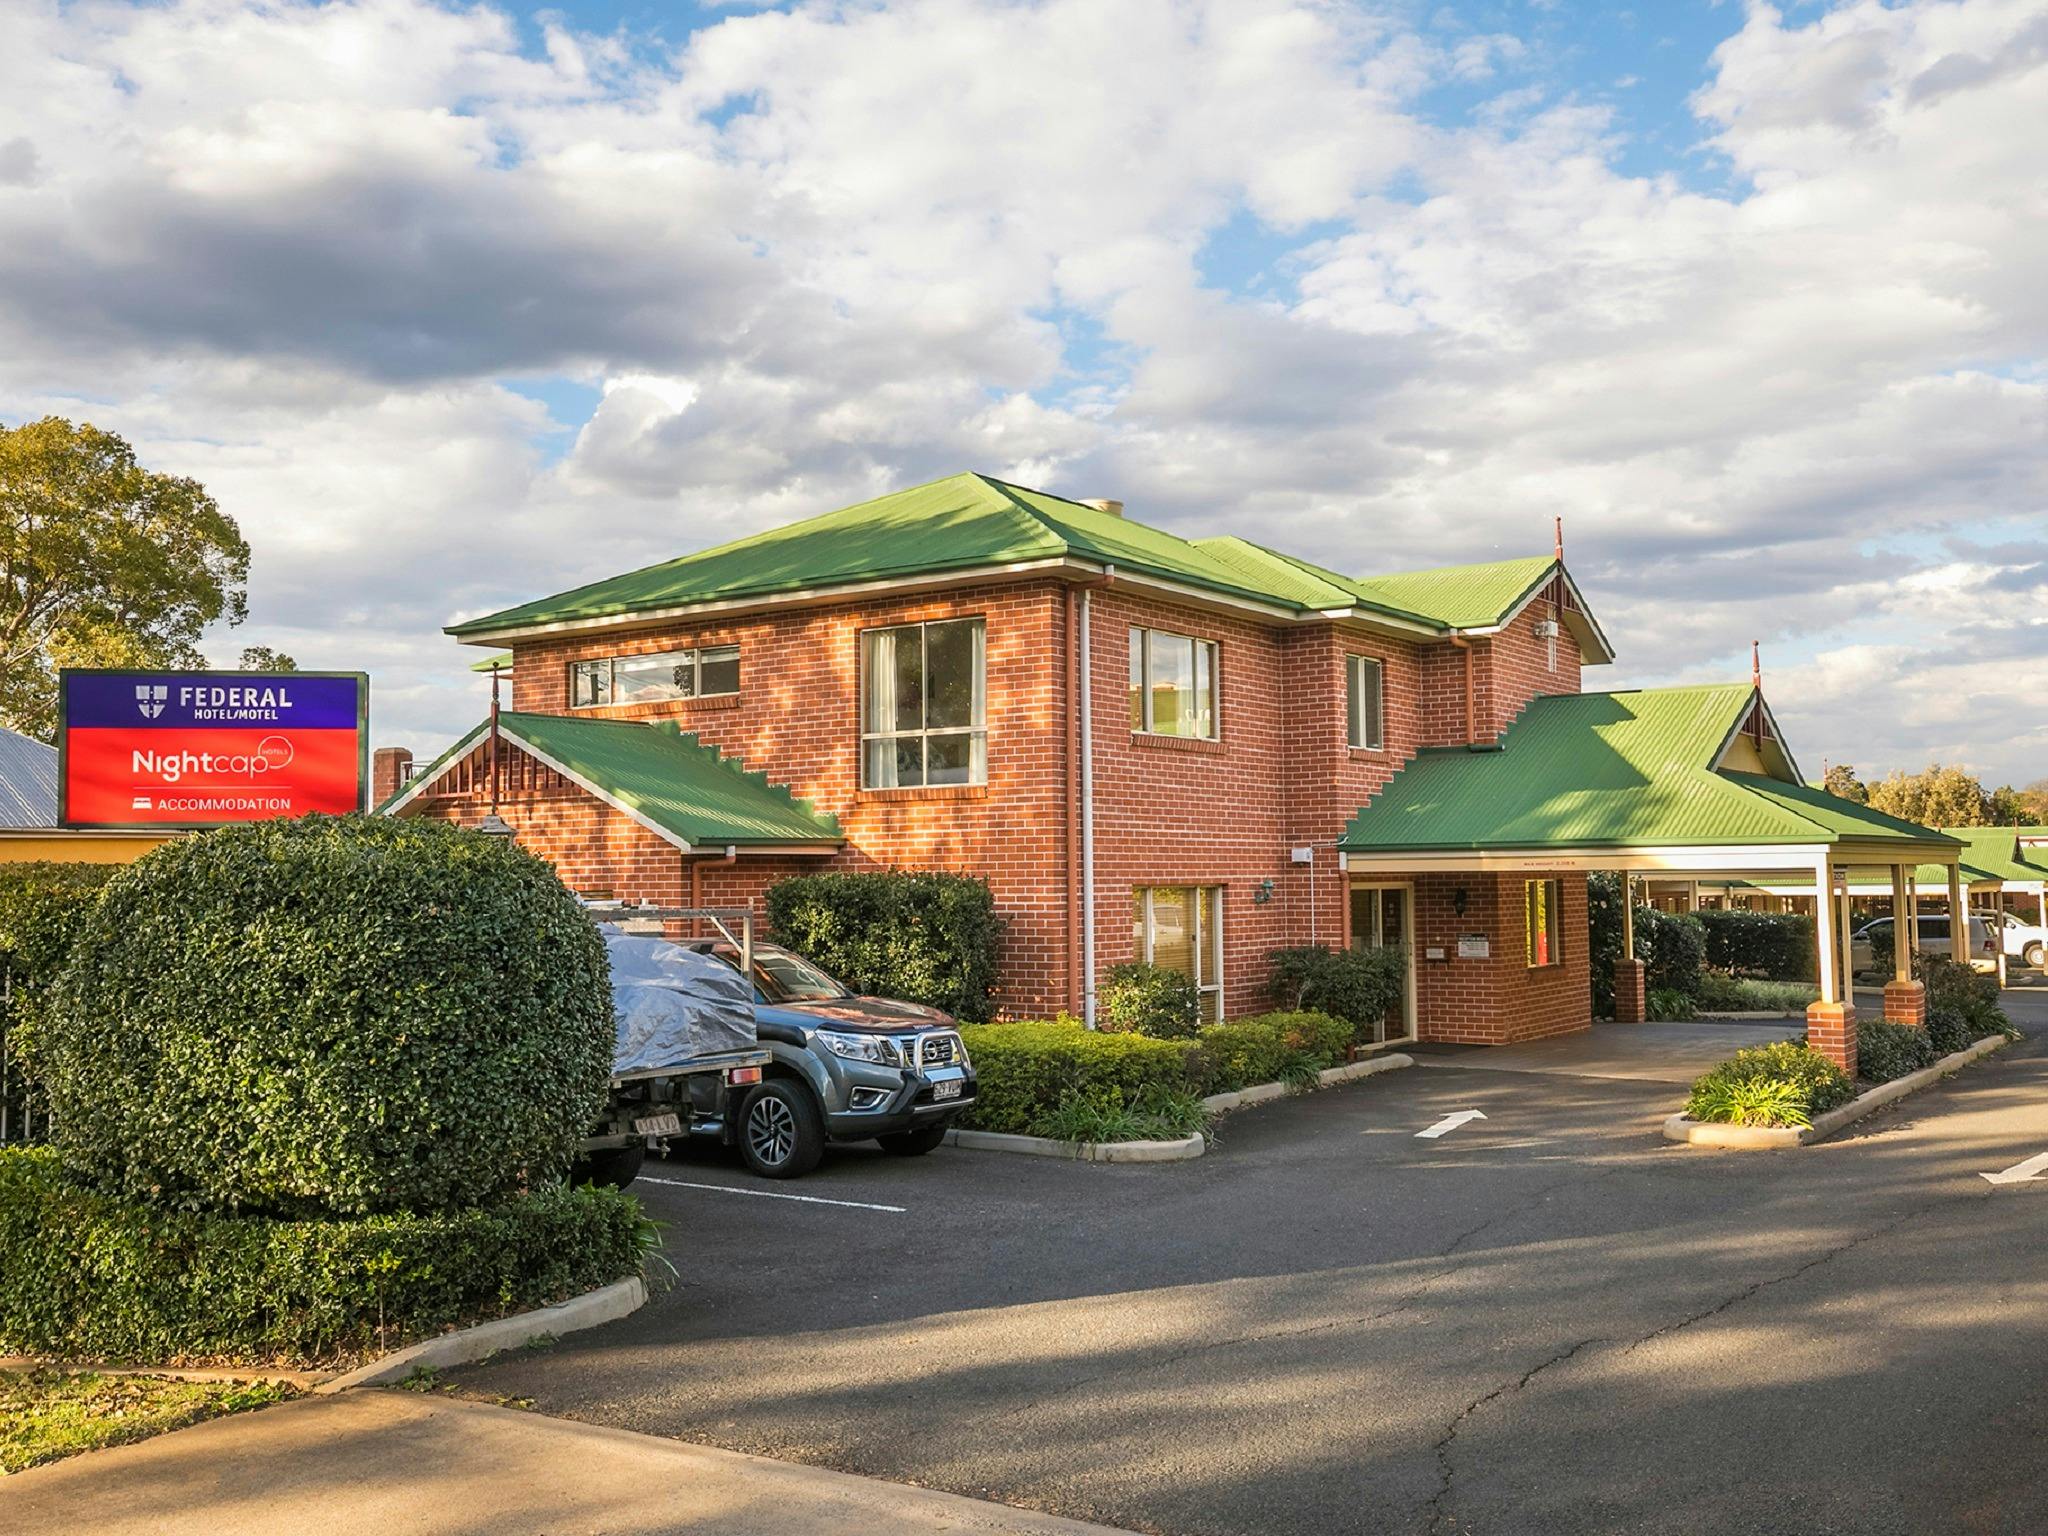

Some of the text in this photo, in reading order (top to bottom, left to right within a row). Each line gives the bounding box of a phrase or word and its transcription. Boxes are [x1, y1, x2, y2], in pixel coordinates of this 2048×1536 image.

[180, 686, 293, 708] FEDERAL
[194, 708, 279, 720] HOTEL/MOTEL
[132, 749, 269, 782] Nightcap
[157, 797, 291, 811] ACCOMMODATION
